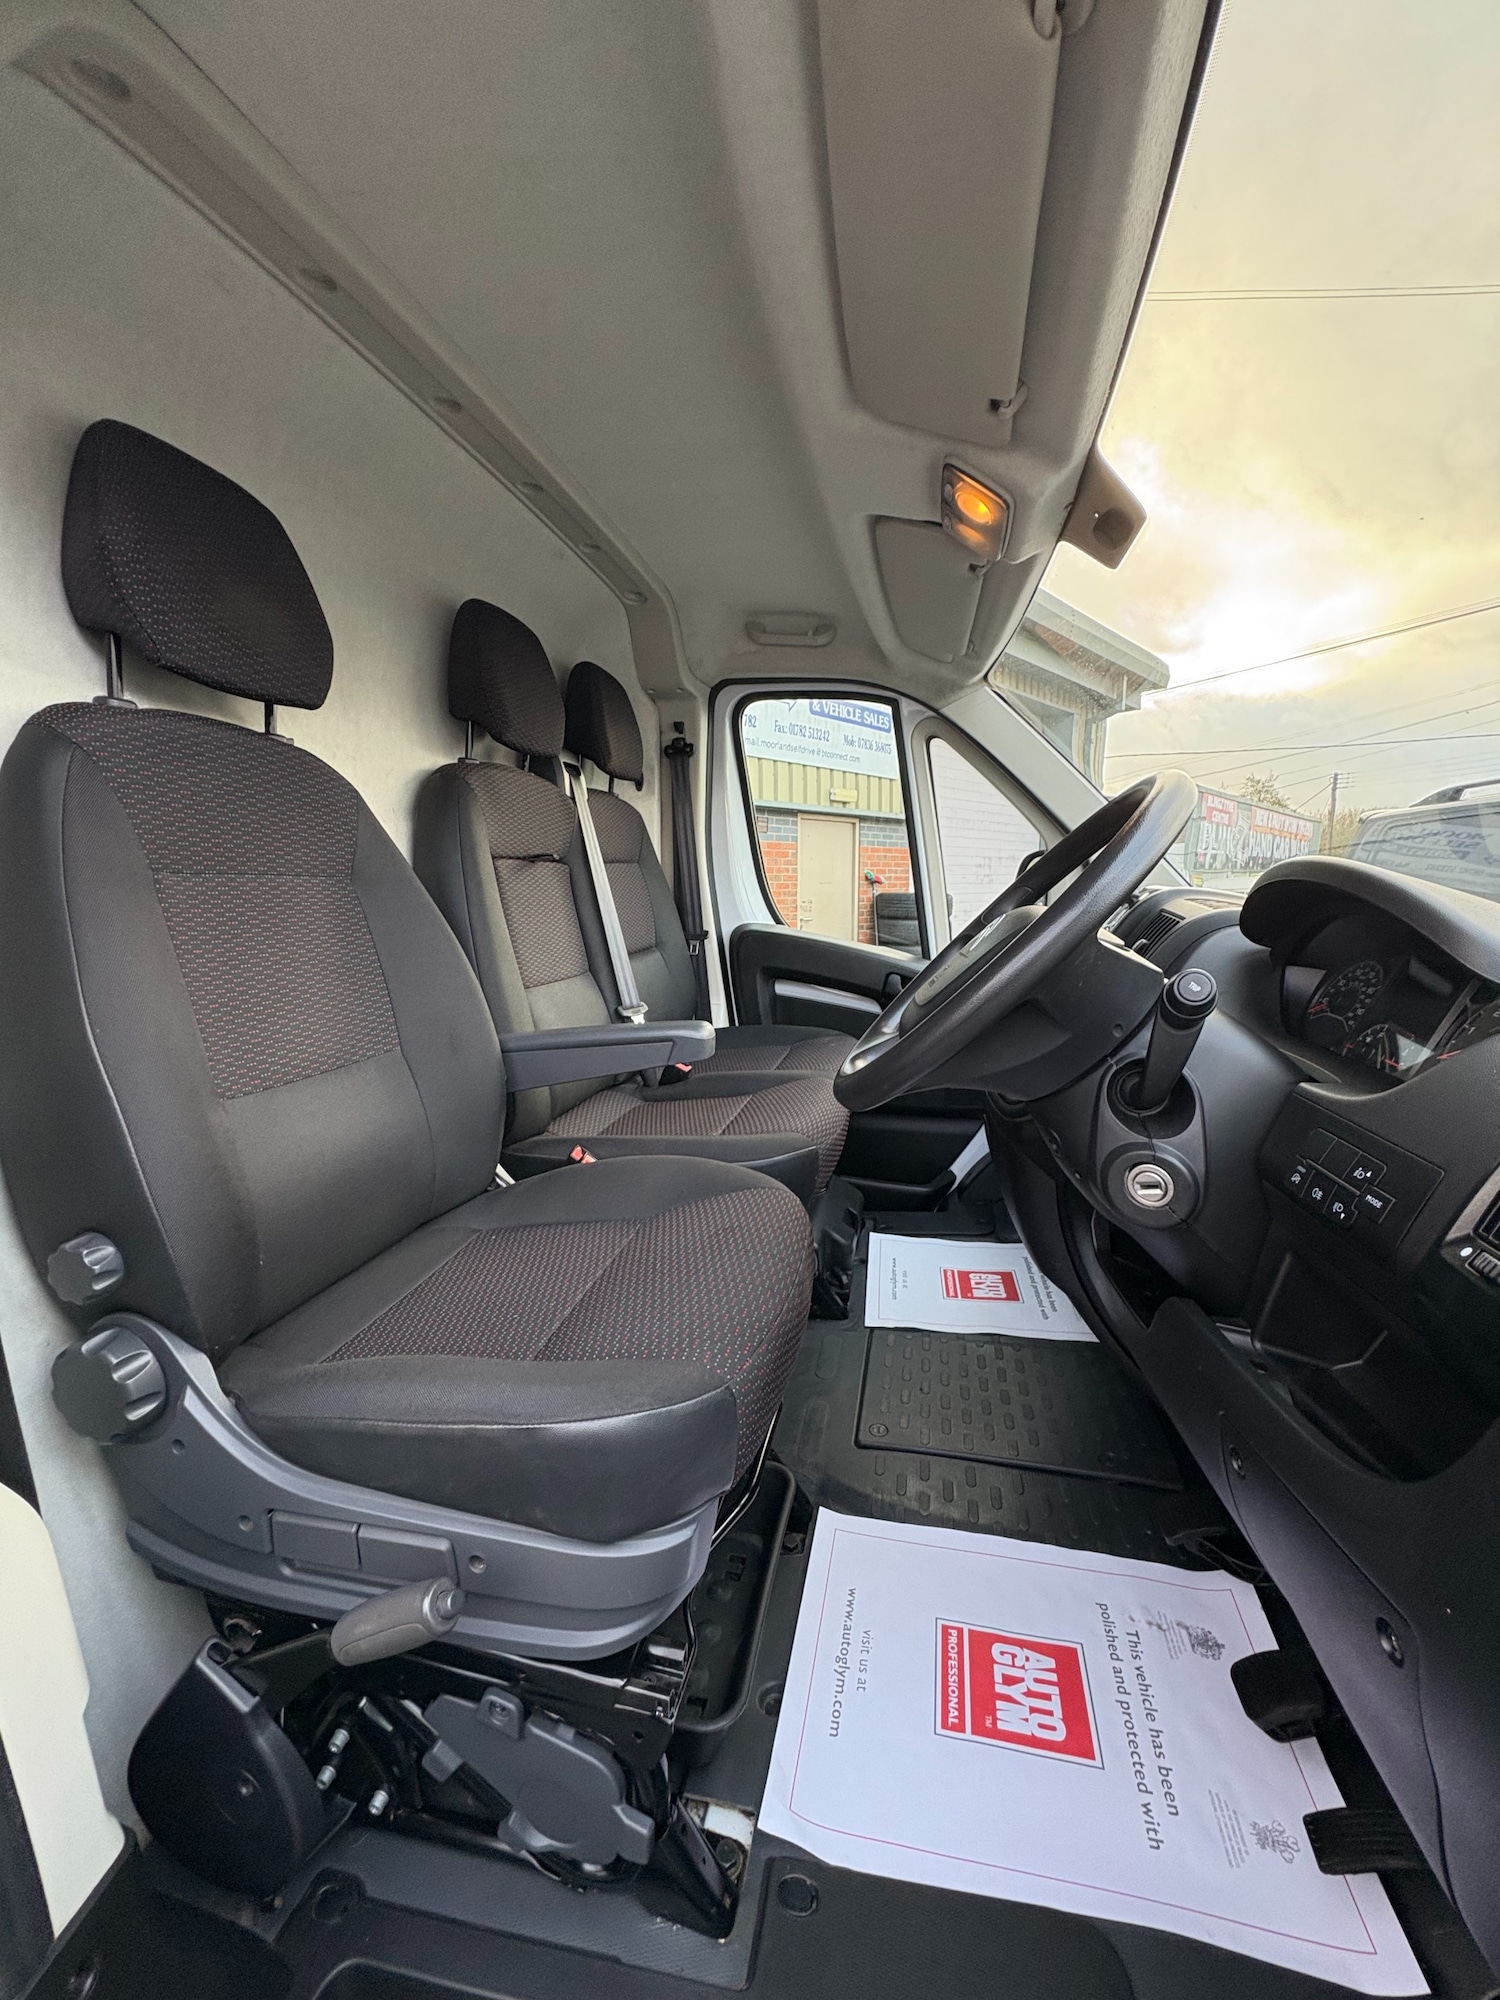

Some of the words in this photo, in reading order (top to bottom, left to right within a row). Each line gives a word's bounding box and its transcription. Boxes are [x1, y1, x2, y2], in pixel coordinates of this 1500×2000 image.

[774, 720, 788, 735] Fax:
[788, 722, 807, 738] 01782
[822, 700, 862, 722] VEHICLE
[863, 711, 890, 730] SALES
[1249, 830, 1273, 858] HAND
[1273, 835, 1290, 859] CAR
[1365, 1194, 1384, 1209] MODE
[986, 1273, 1007, 1299] AUTO
[860, 1629, 873, 1655] visit
[1095, 1601, 1124, 1662] polished
[1126, 1629, 1141, 1661] This
[829, 1587, 856, 1738] www.autoglym.com
[858, 1659, 868, 1674] us
[947, 1629, 960, 1727] PROFESSIONAL
[856, 1677, 867, 1692] at
[991, 1642, 1033, 1736] GLYM
[1022, 1647, 1067, 1742] AUTO
[1112, 1665, 1131, 1696] and
[1135, 1665, 1158, 1722] vehicle
[984, 1715, 992, 1728] TM
[1115, 1698, 1153, 1795] protected
[1149, 1726, 1166, 1760] has
[1157, 1764, 1180, 1817] been
[1141, 1801, 1164, 1851] with
